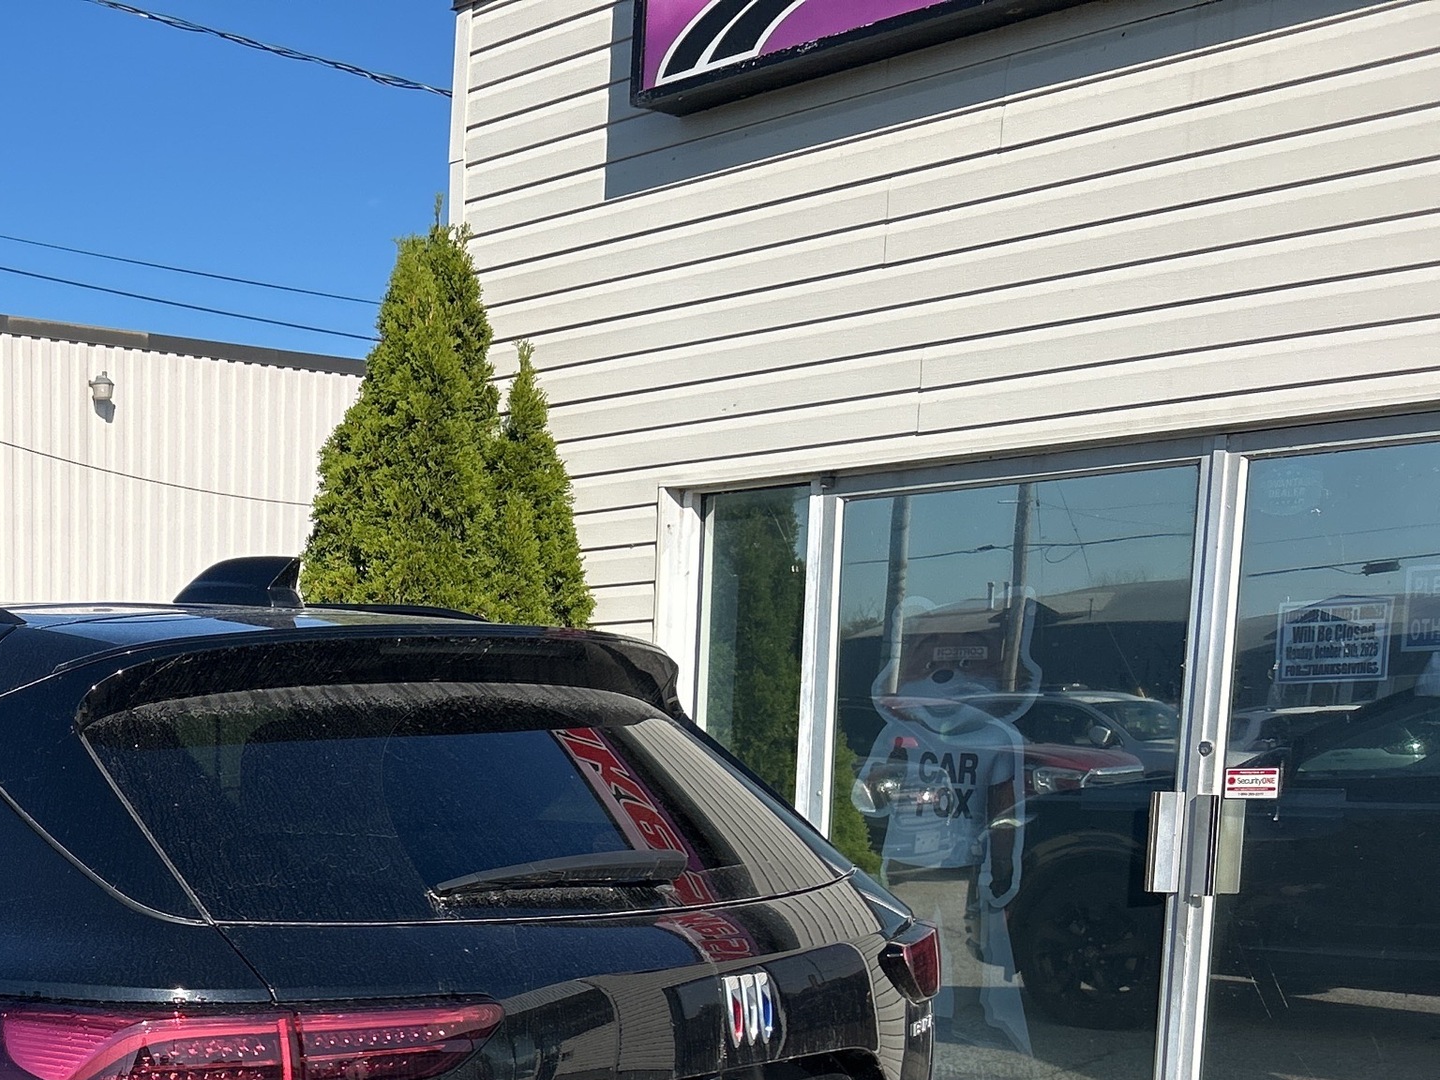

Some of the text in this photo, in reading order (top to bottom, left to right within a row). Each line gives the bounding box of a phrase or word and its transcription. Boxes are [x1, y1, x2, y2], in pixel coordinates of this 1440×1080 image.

[1292, 622, 1376, 643] Will Be Closed
[918, 751, 979, 785] CAR
